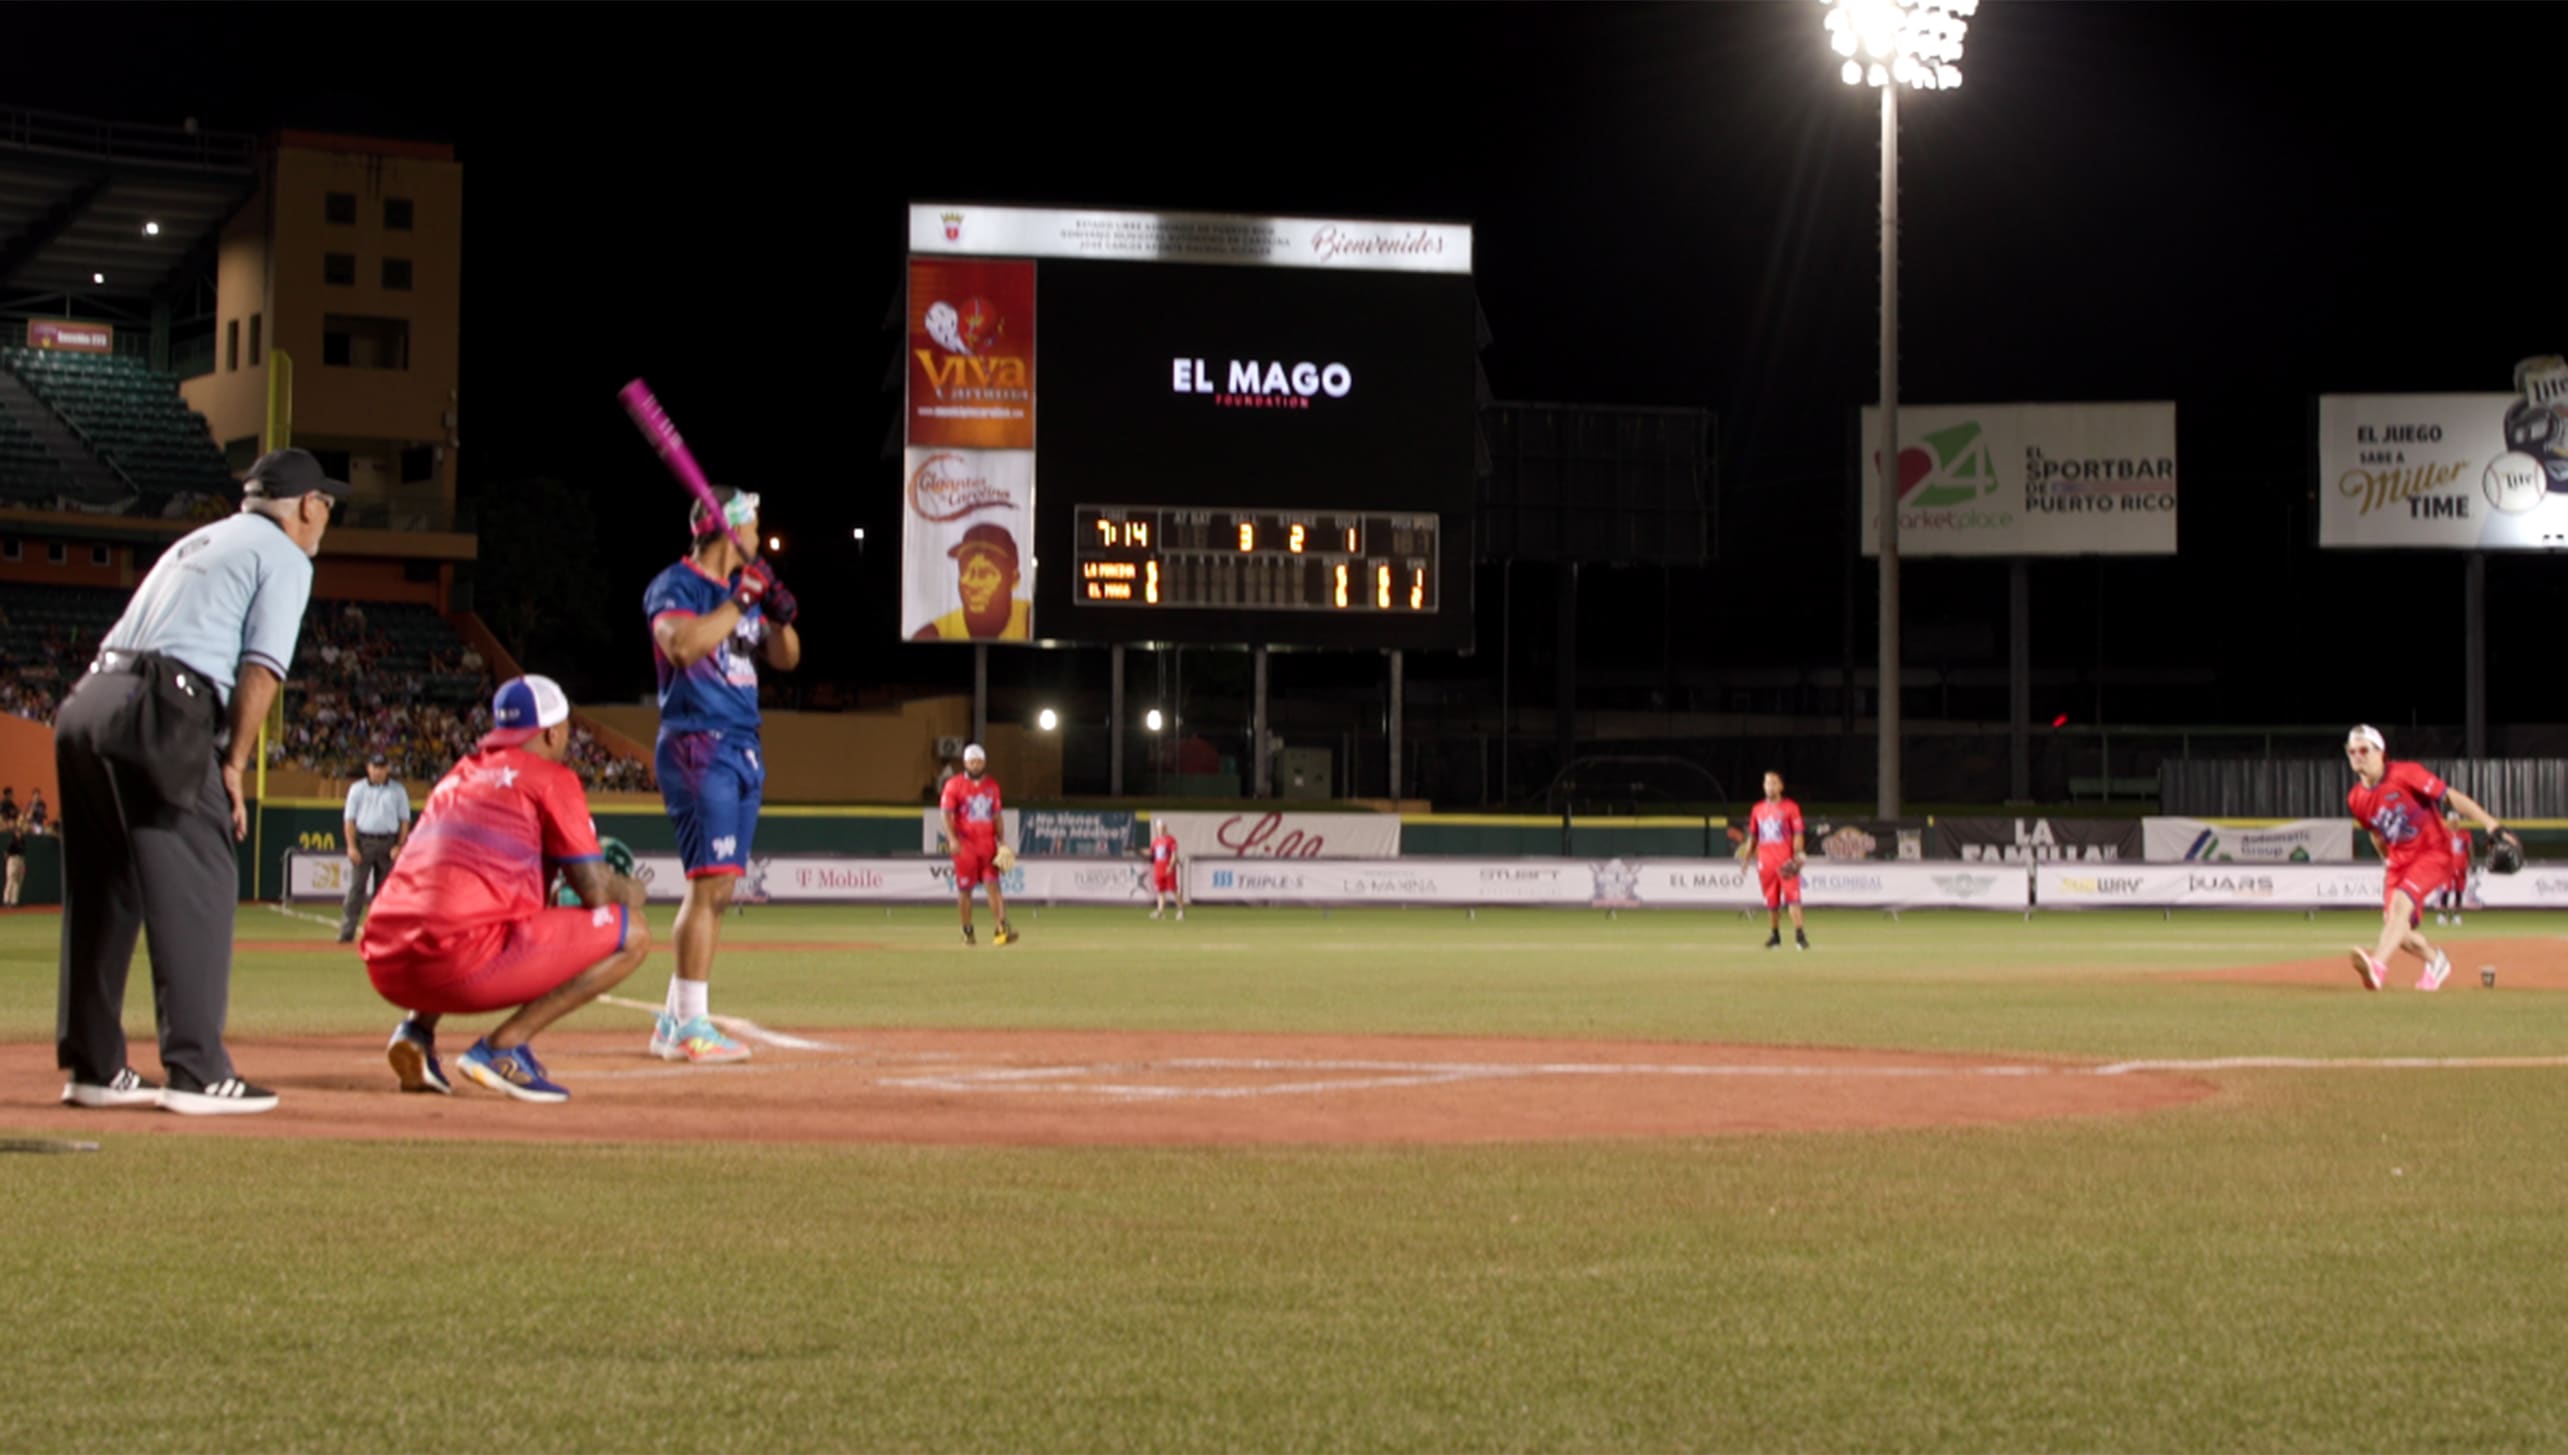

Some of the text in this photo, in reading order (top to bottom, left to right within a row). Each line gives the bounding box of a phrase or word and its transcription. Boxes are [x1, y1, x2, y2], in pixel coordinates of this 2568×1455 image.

[1311, 222, 1443, 263] Bienvenidos
[1173, 358, 1351, 397] EL MAGO
[1215, 394, 1309, 408] FOUNDATION
[2357, 425, 2443, 443] EL JUEGO
[2026, 446, 2044, 459] EL
[2360, 452, 2404, 464] SABE A
[2026, 459, 2173, 482] SPORTBAR
[2026, 483, 2049, 495] DE
[2339, 460, 2462, 516] Miller
[2026, 494, 2175, 512] PUERTO RICO
[2408, 495, 2469, 519] TIME
[1097, 519, 1147, 547] 7:14
[1874, 510, 2013, 533] arketplace
[1239, 523, 1253, 551] 3
[1290, 523, 1304, 553] 2
[1349, 527, 1355, 552] 1
[2015, 818, 2055, 846] LA
[819, 868, 883, 888] Mobile
[1669, 875, 1745, 888] EL MAGO
[2061, 878, 2139, 893] SUBWAY
